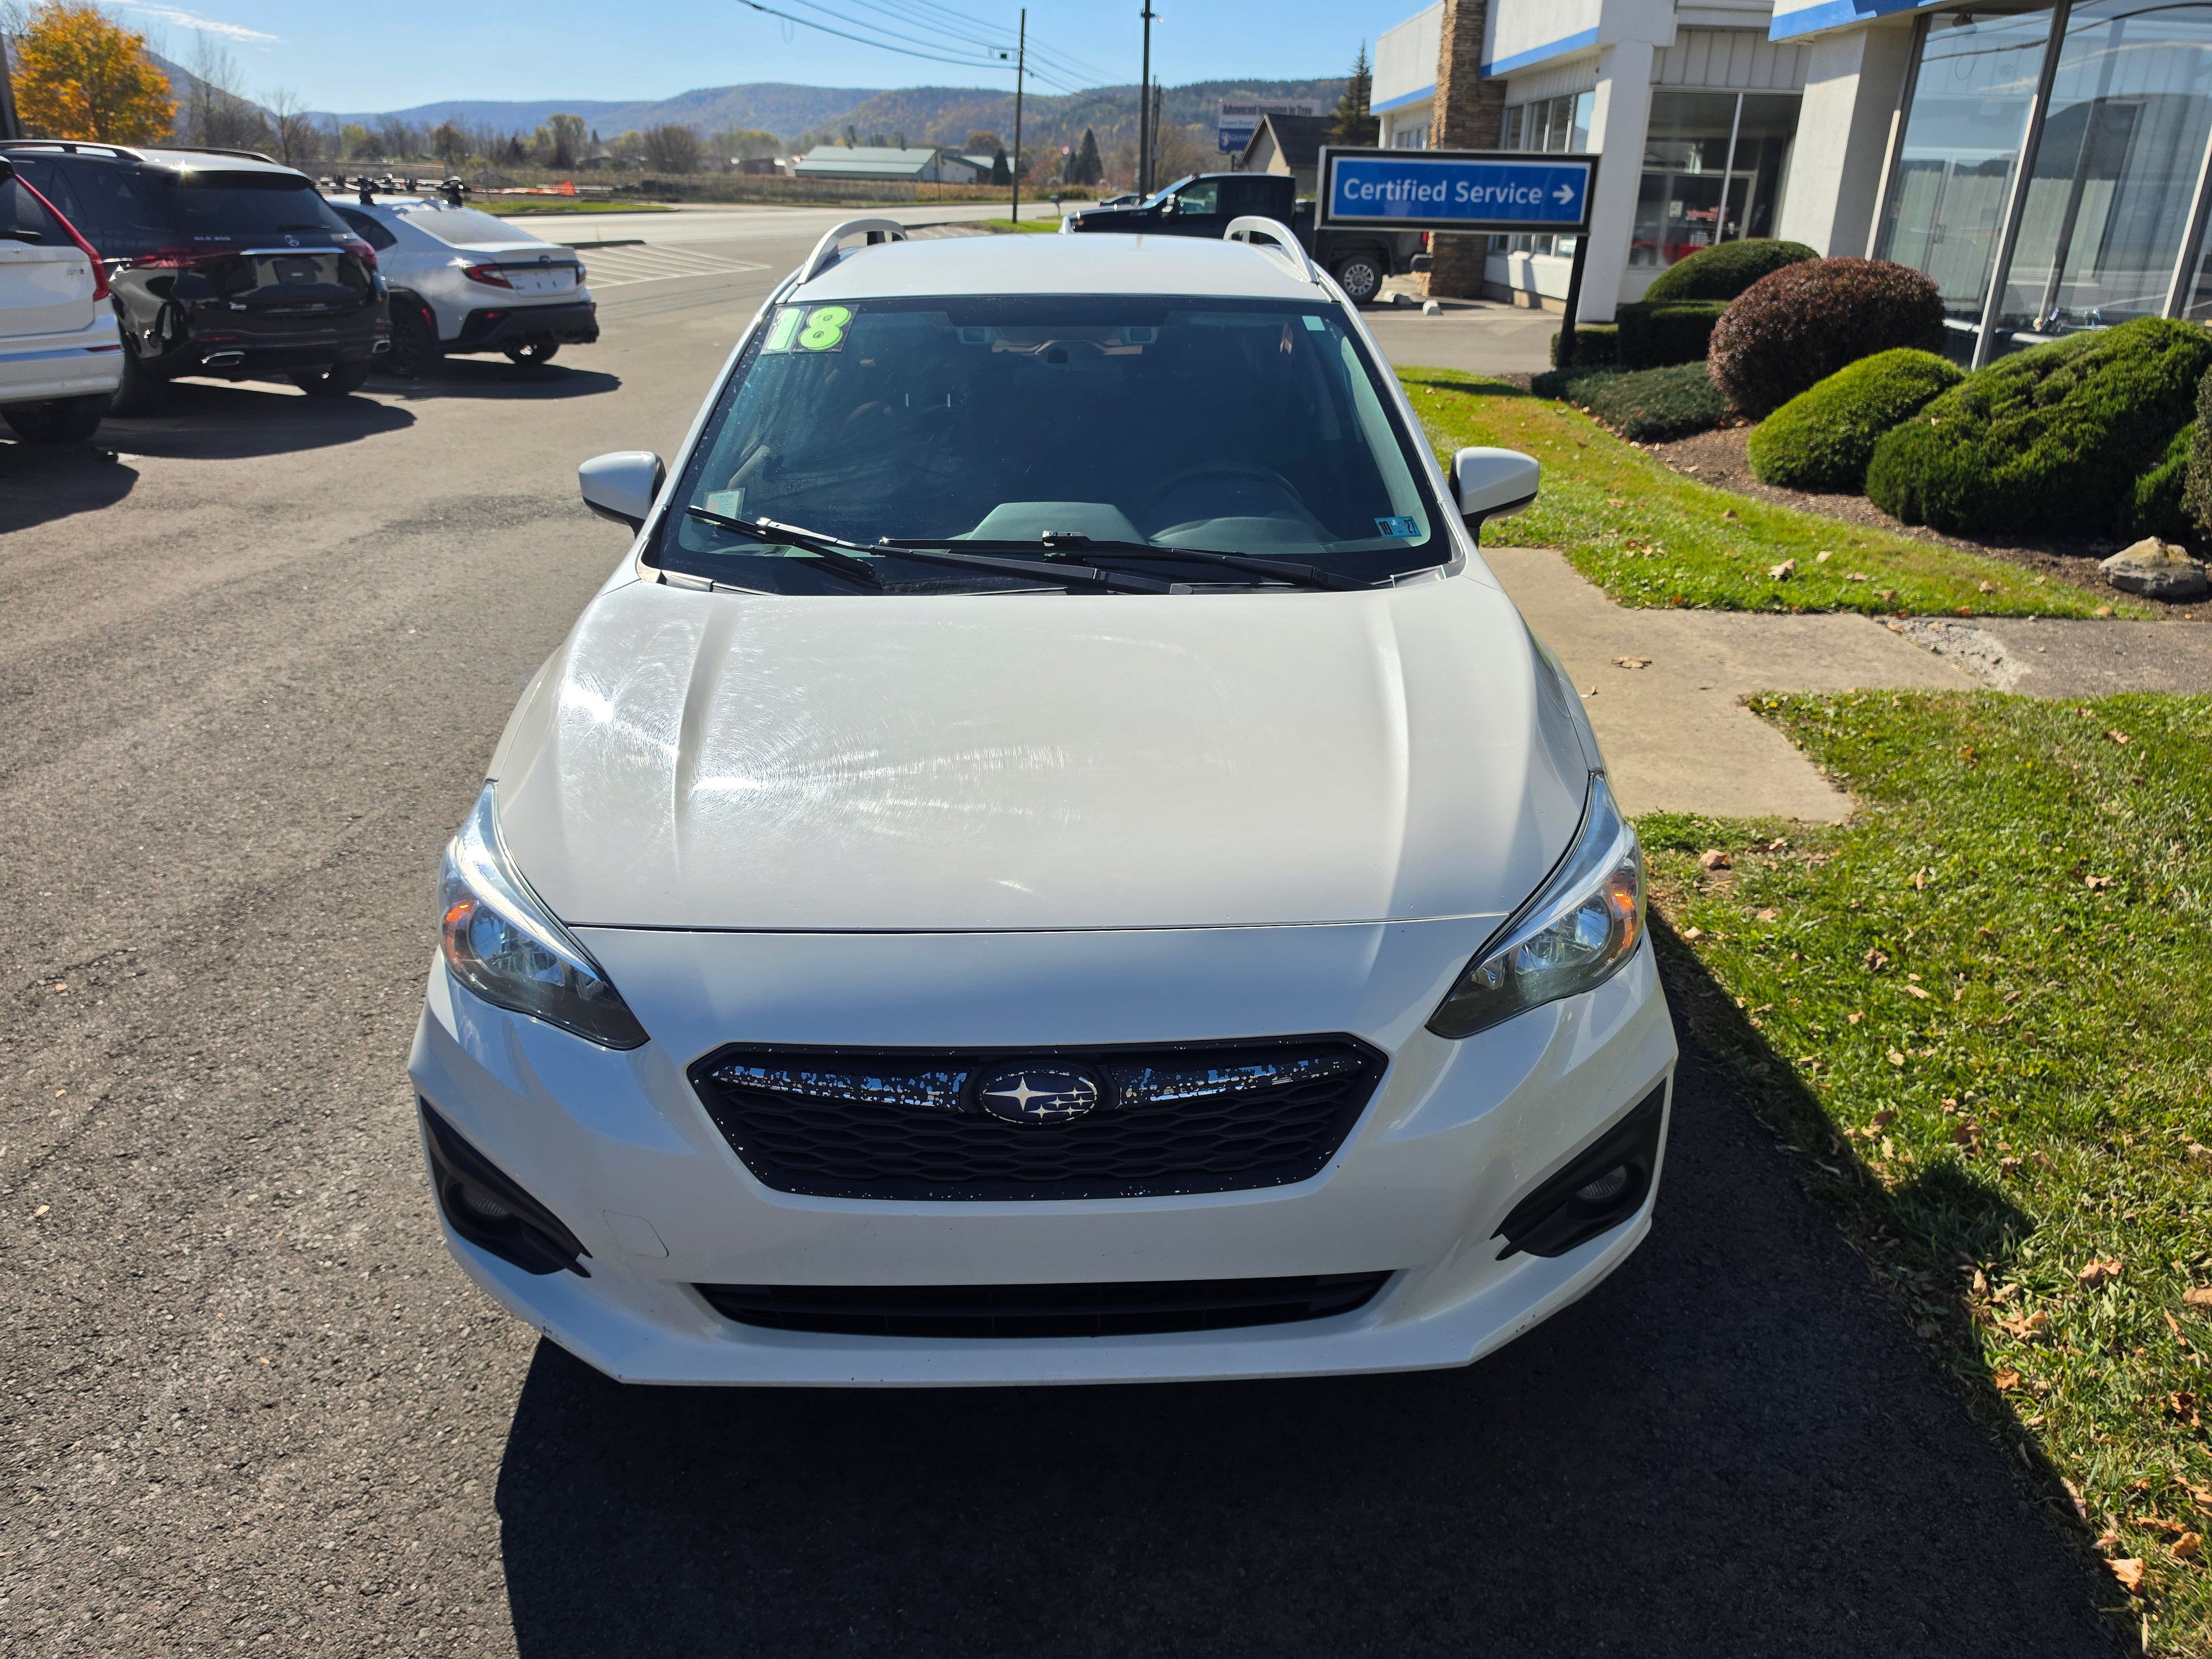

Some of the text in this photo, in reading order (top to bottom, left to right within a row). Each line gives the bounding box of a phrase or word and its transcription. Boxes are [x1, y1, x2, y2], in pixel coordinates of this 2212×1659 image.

[1343, 178, 1543, 205] Certified Service
[766, 306, 852, 351] 18
[1378, 521, 1394, 535] 10
